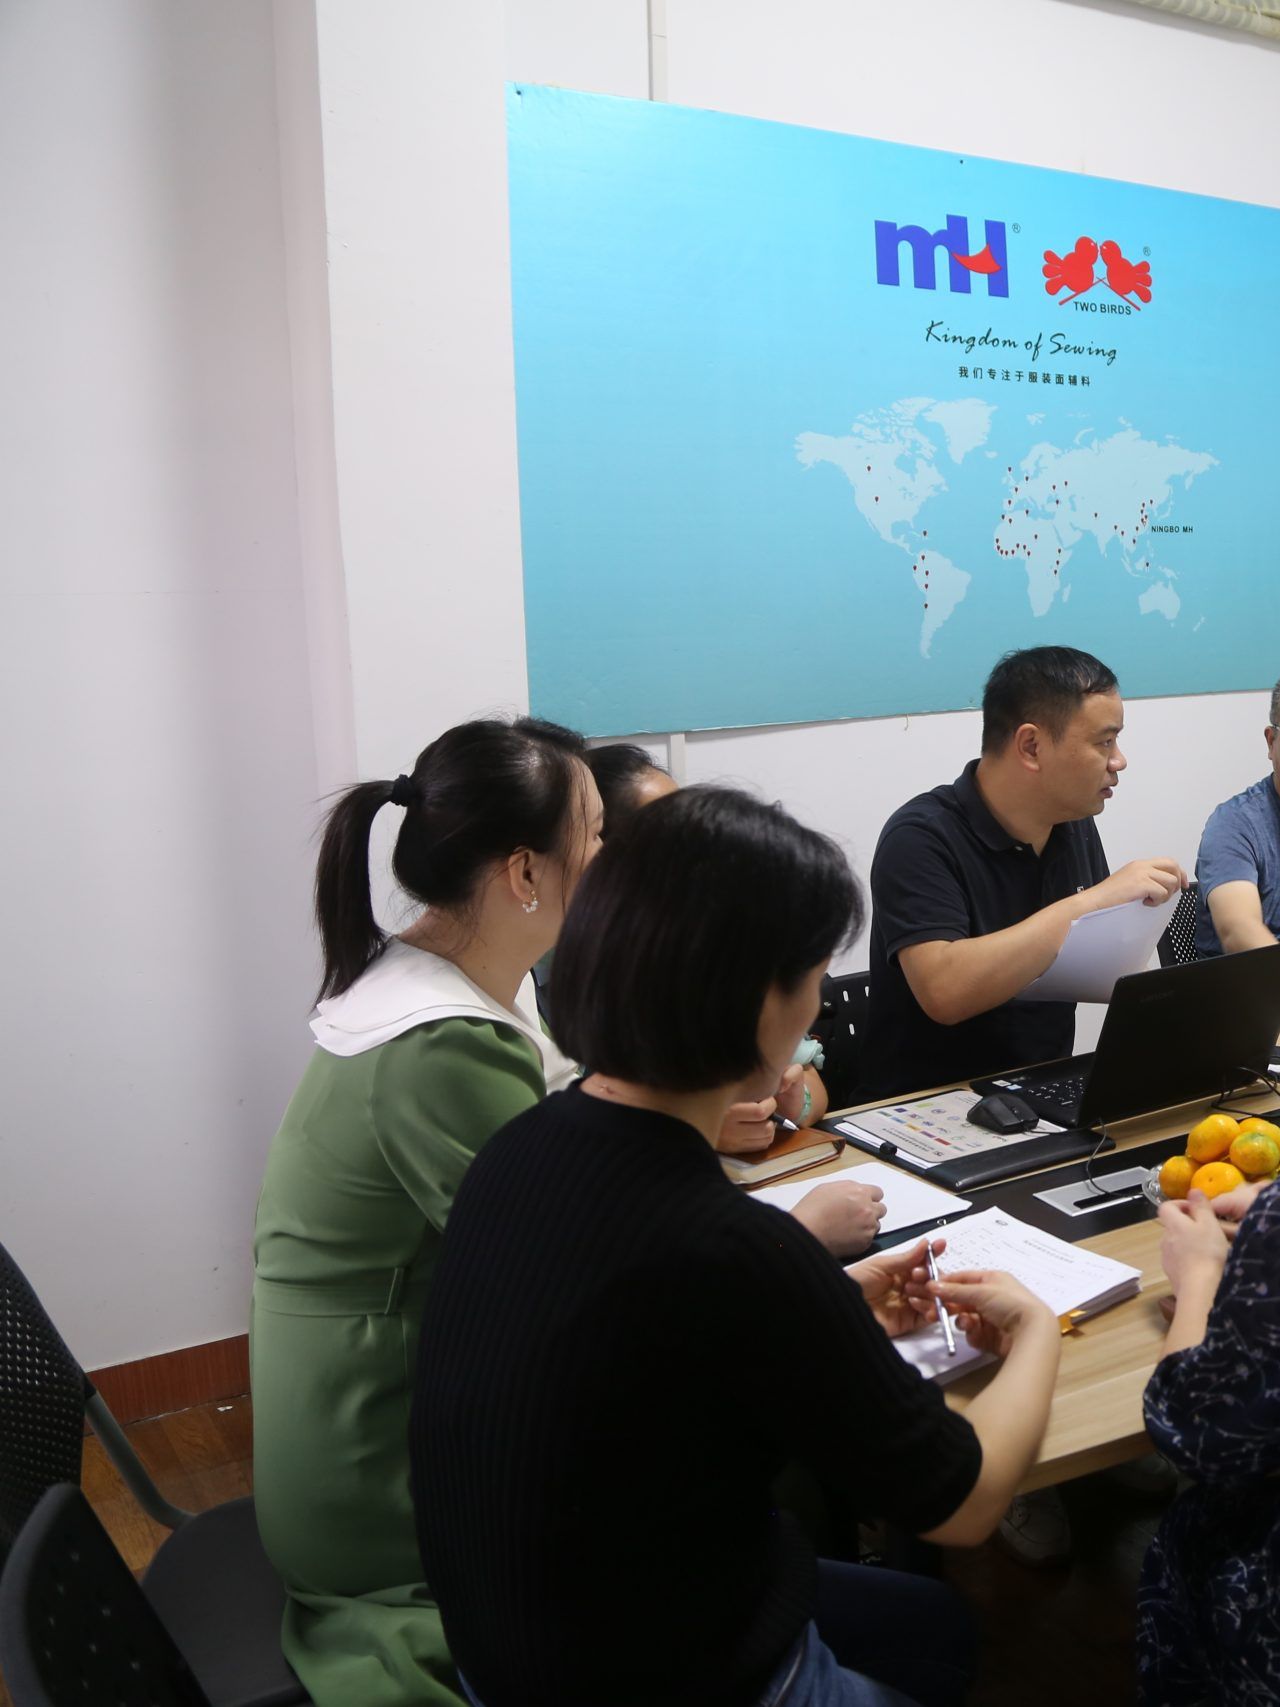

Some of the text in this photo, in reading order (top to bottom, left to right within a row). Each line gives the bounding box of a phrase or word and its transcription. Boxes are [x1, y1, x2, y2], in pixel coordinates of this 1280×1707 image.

[1073, 301, 1132, 315] TWO BIRDS
[925, 320, 1117, 366] Kingdom of Sewing
[958, 366, 1091, 387] 我们专注于服装面辅料
[1151, 525, 1194, 533] NINGBO MH
